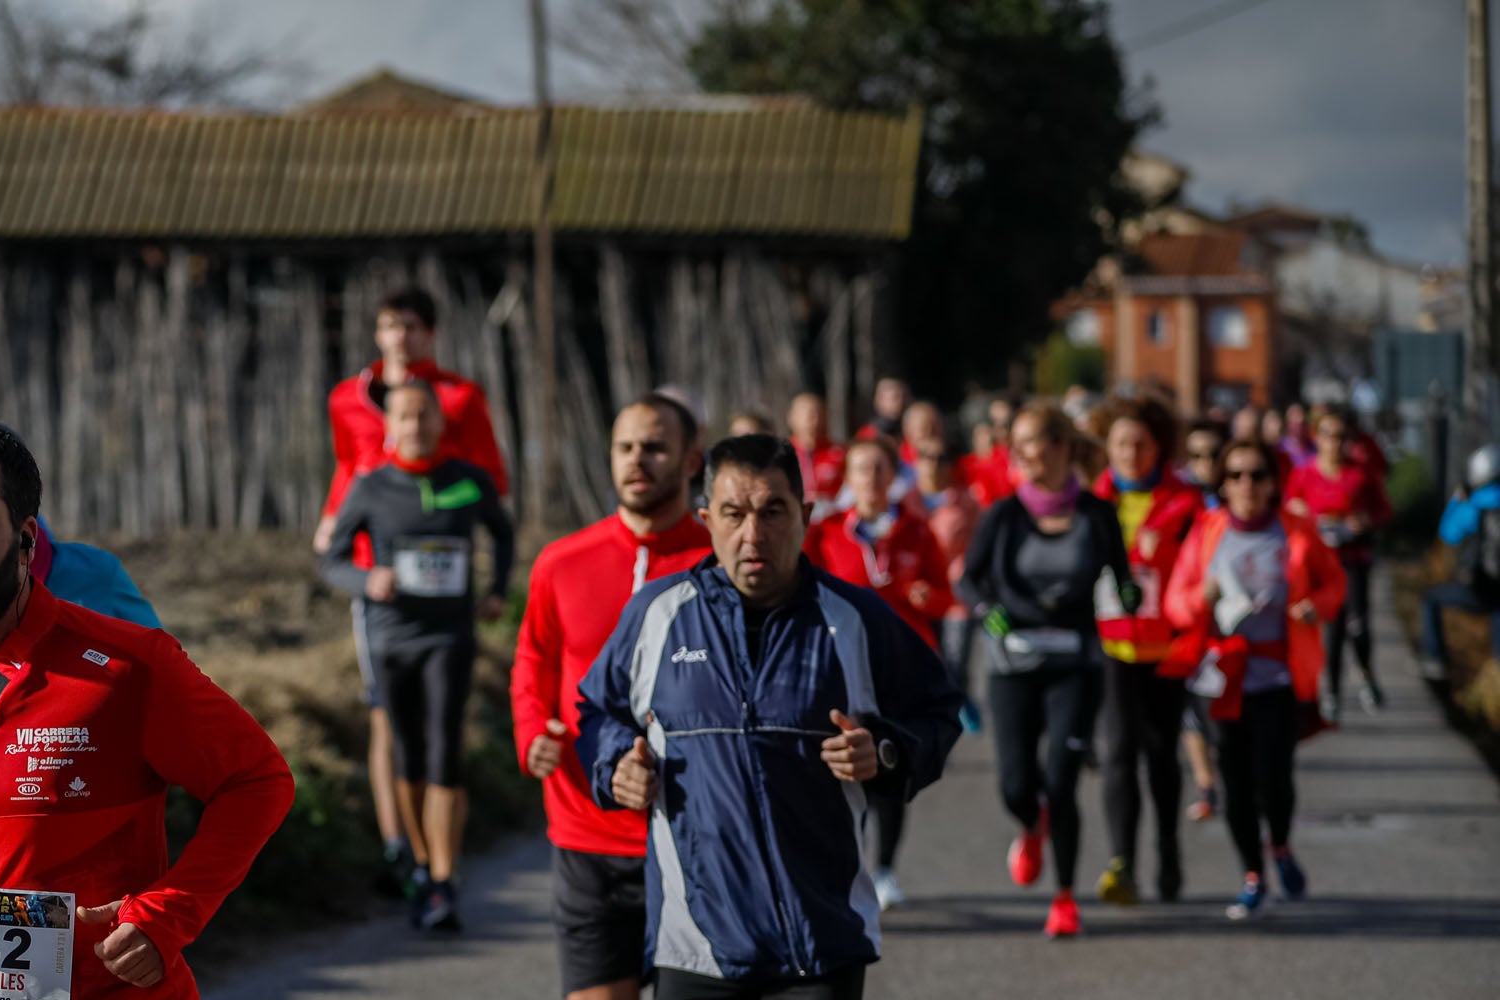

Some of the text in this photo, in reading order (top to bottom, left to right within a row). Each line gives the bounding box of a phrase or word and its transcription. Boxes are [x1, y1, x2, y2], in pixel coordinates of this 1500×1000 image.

[16, 727, 89, 745] VII CARRERA
[34, 735, 89, 744] POPULAR
[5, 743, 28, 755] Ruta
[30, 743, 41, 752] de
[43, 743, 57, 752] los
[40, 756, 74, 766] olimpo
